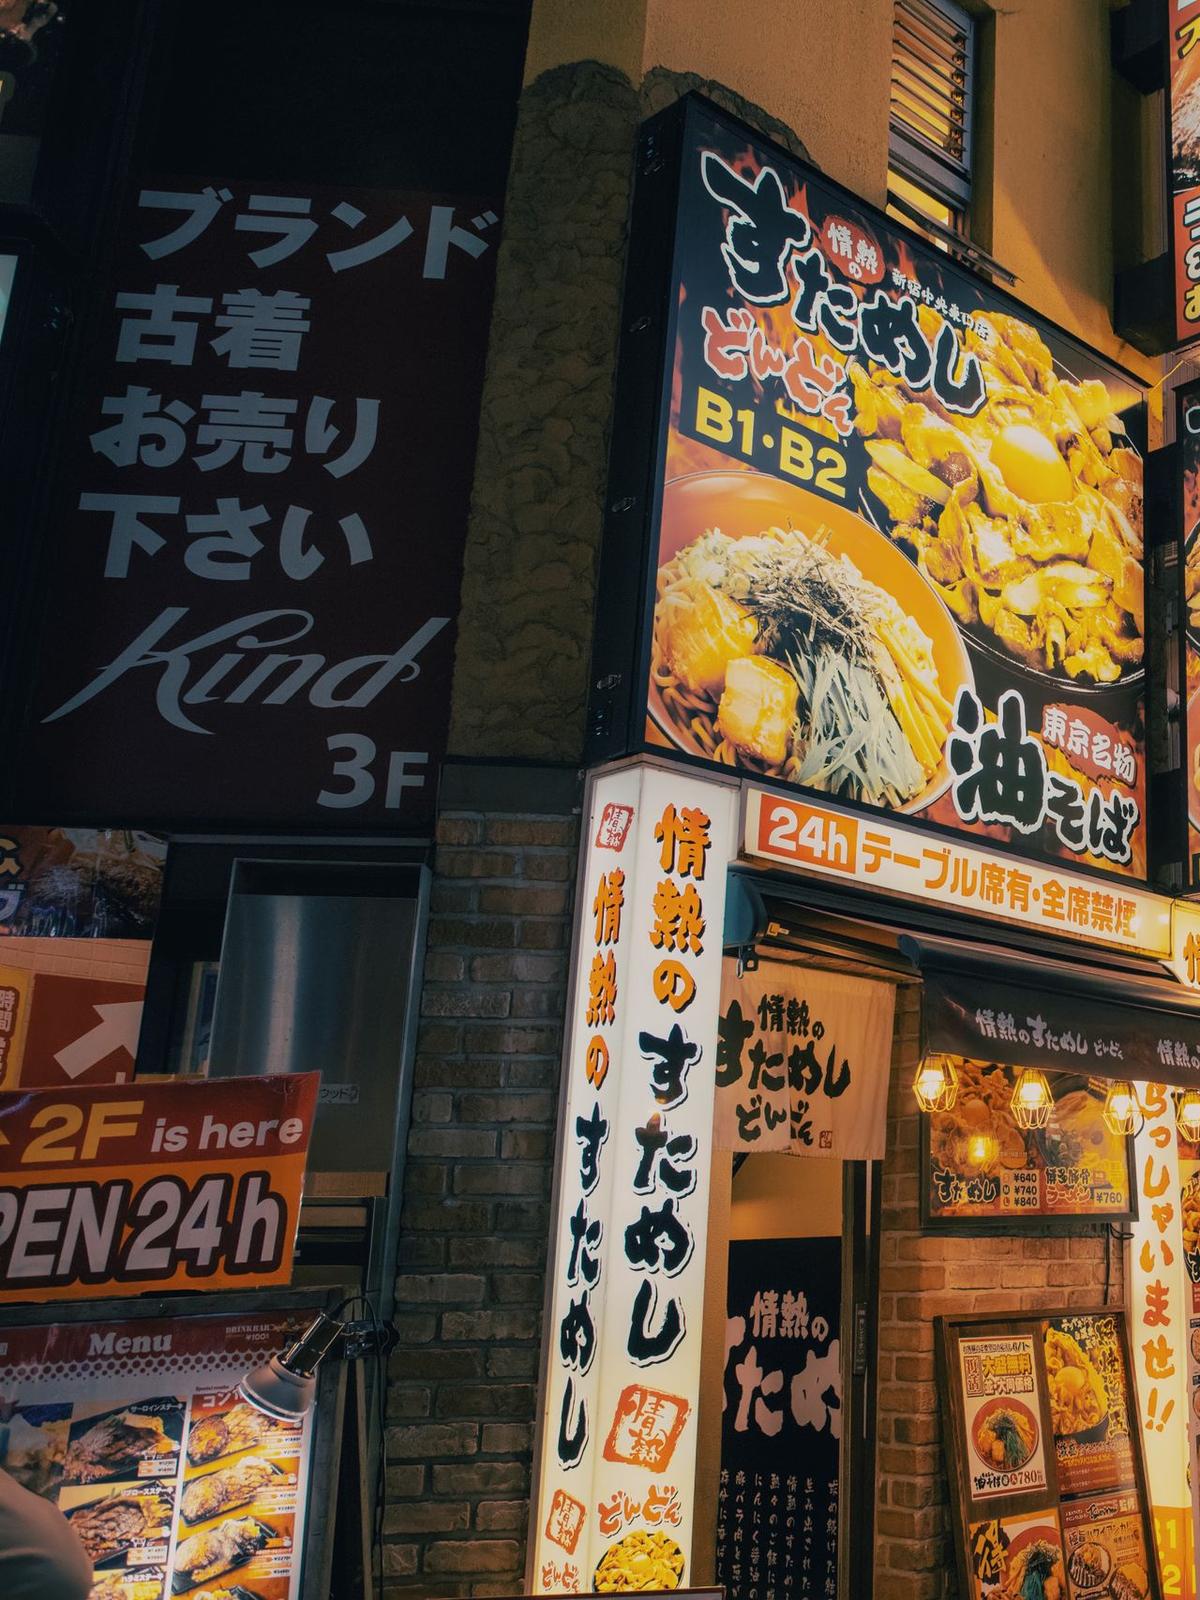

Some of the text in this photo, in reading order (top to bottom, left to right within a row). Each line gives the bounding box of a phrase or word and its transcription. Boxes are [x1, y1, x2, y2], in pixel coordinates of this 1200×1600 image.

[137, 186, 499, 280] ブランド
[700, 150, 988, 416] すためし
[114, 284, 312, 372] 古着
[701, 304, 855, 437] どんどん
[88, 385, 381, 479] お売り
[78, 491, 374, 581] 下さい
[40, 606, 452, 736] Kind
[315, 732, 429, 810] 3F
[948, 687, 1142, 868] 油そば
[1041, 701, 1138, 786] 東京名物
[767, 806, 851, 867] 24h
[714, 999, 852, 1099] すためし
[756, 993, 825, 1042] 情熱の
[975, 1006, 1089, 1057] 情熱のすためし
[19, 1099, 304, 1165] 2F is here
[1013, 1173, 1038, 1183] ¥640
[1013, 1185, 1038, 1196] ¥740
[1013, 1196, 1038, 1207] ¥840
[1095, 1191, 1123, 1204] ¥760
[124, 1176, 281, 1273] 24h
[87, 1333, 172, 1357] Menu
[749, 1289, 829, 1342] 情熱の
